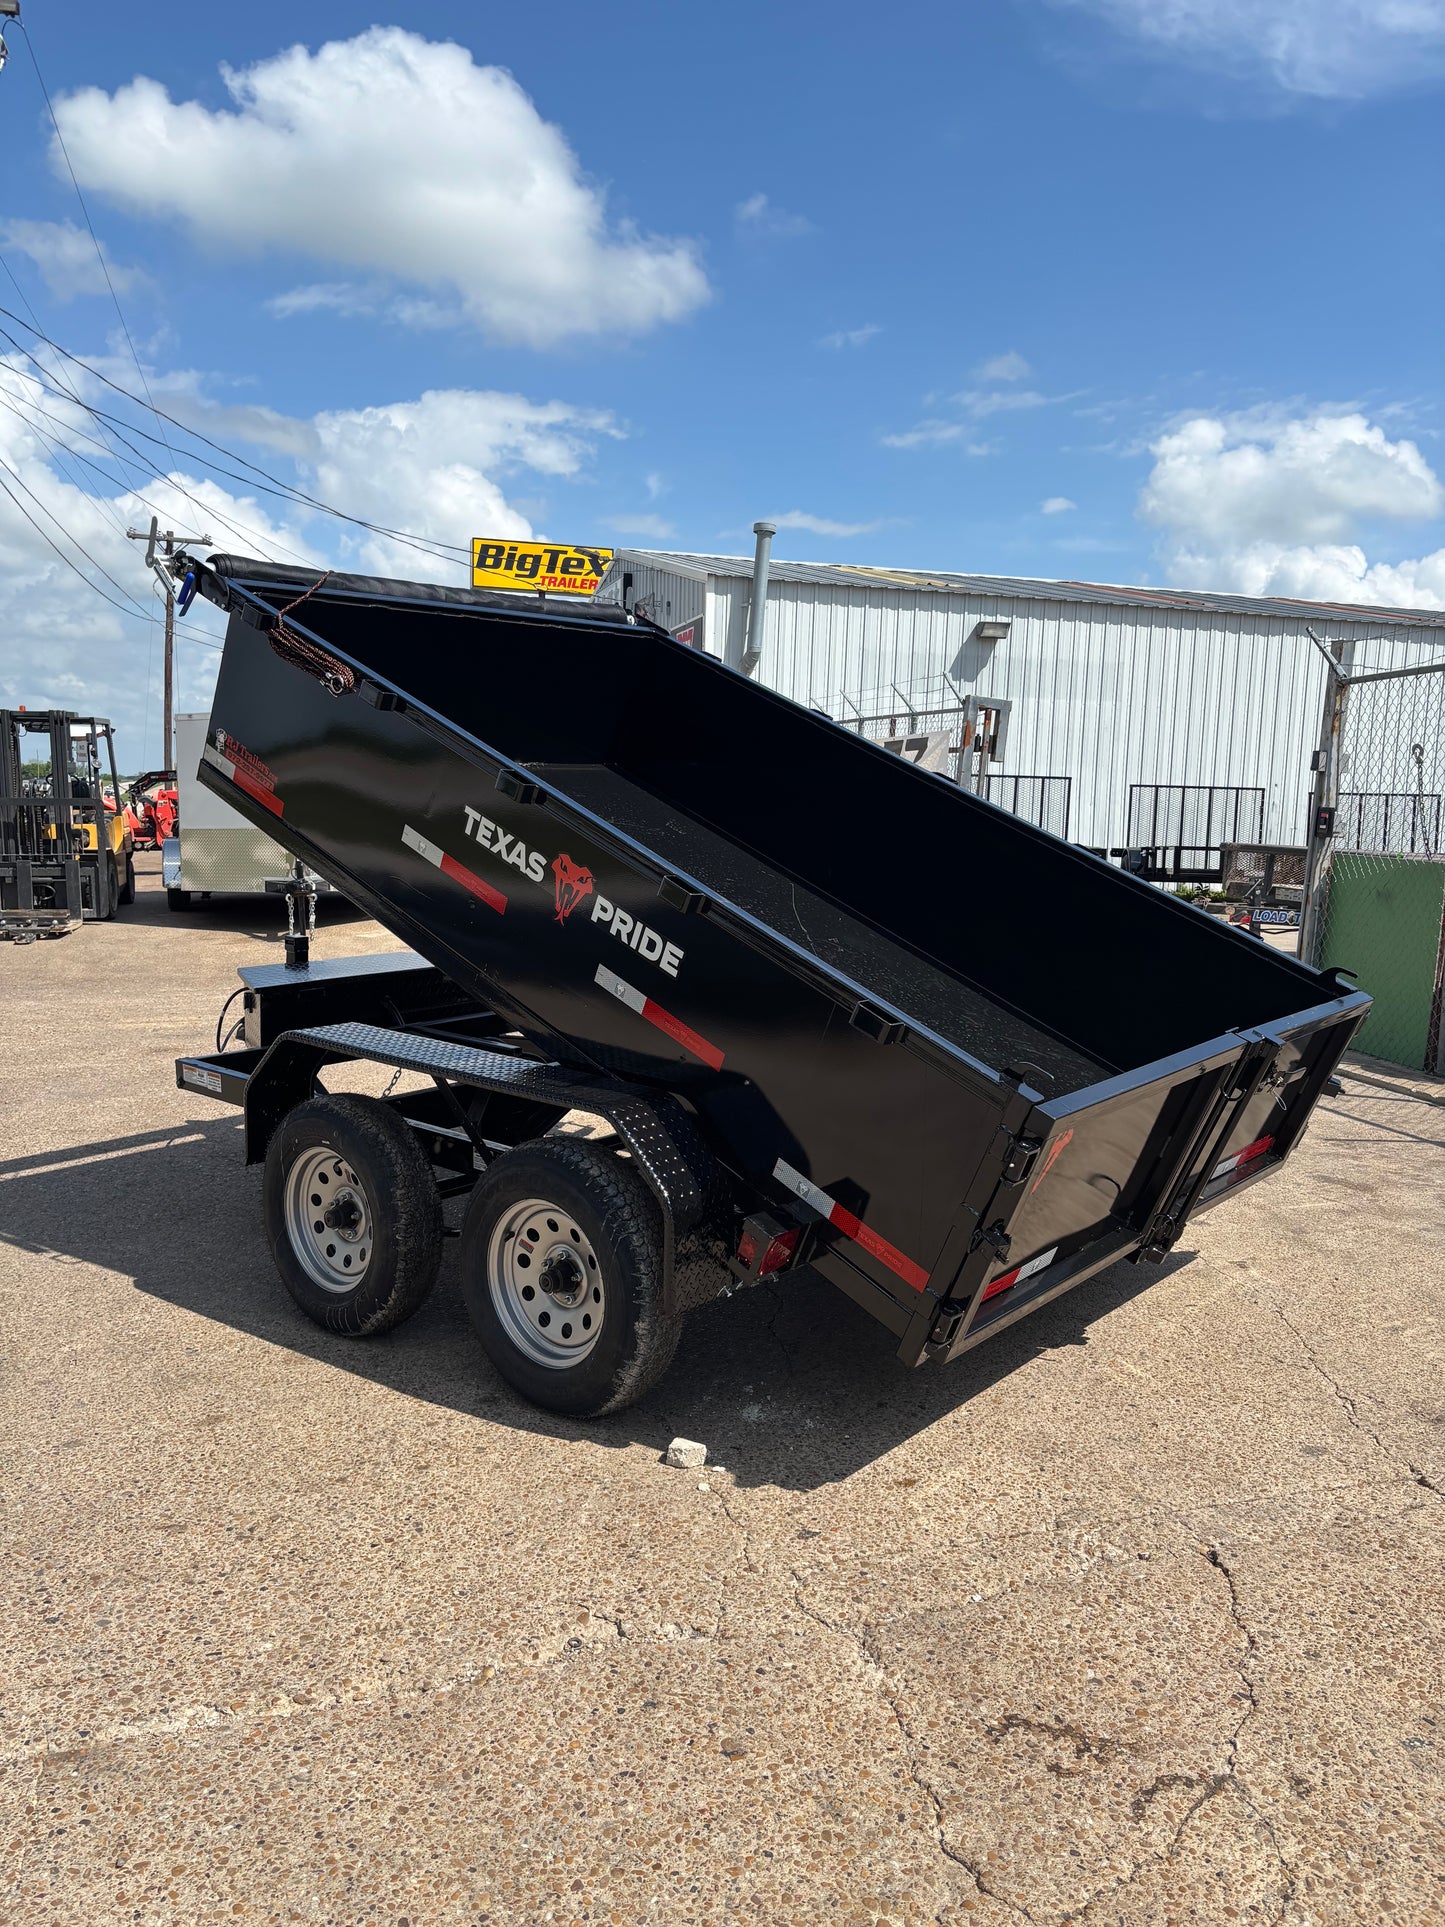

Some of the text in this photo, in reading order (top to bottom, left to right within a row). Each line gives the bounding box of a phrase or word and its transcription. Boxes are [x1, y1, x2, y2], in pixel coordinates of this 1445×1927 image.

[464, 805, 685, 979] TEXAS PRIDE
[1253, 910, 1288, 924] LOAD
